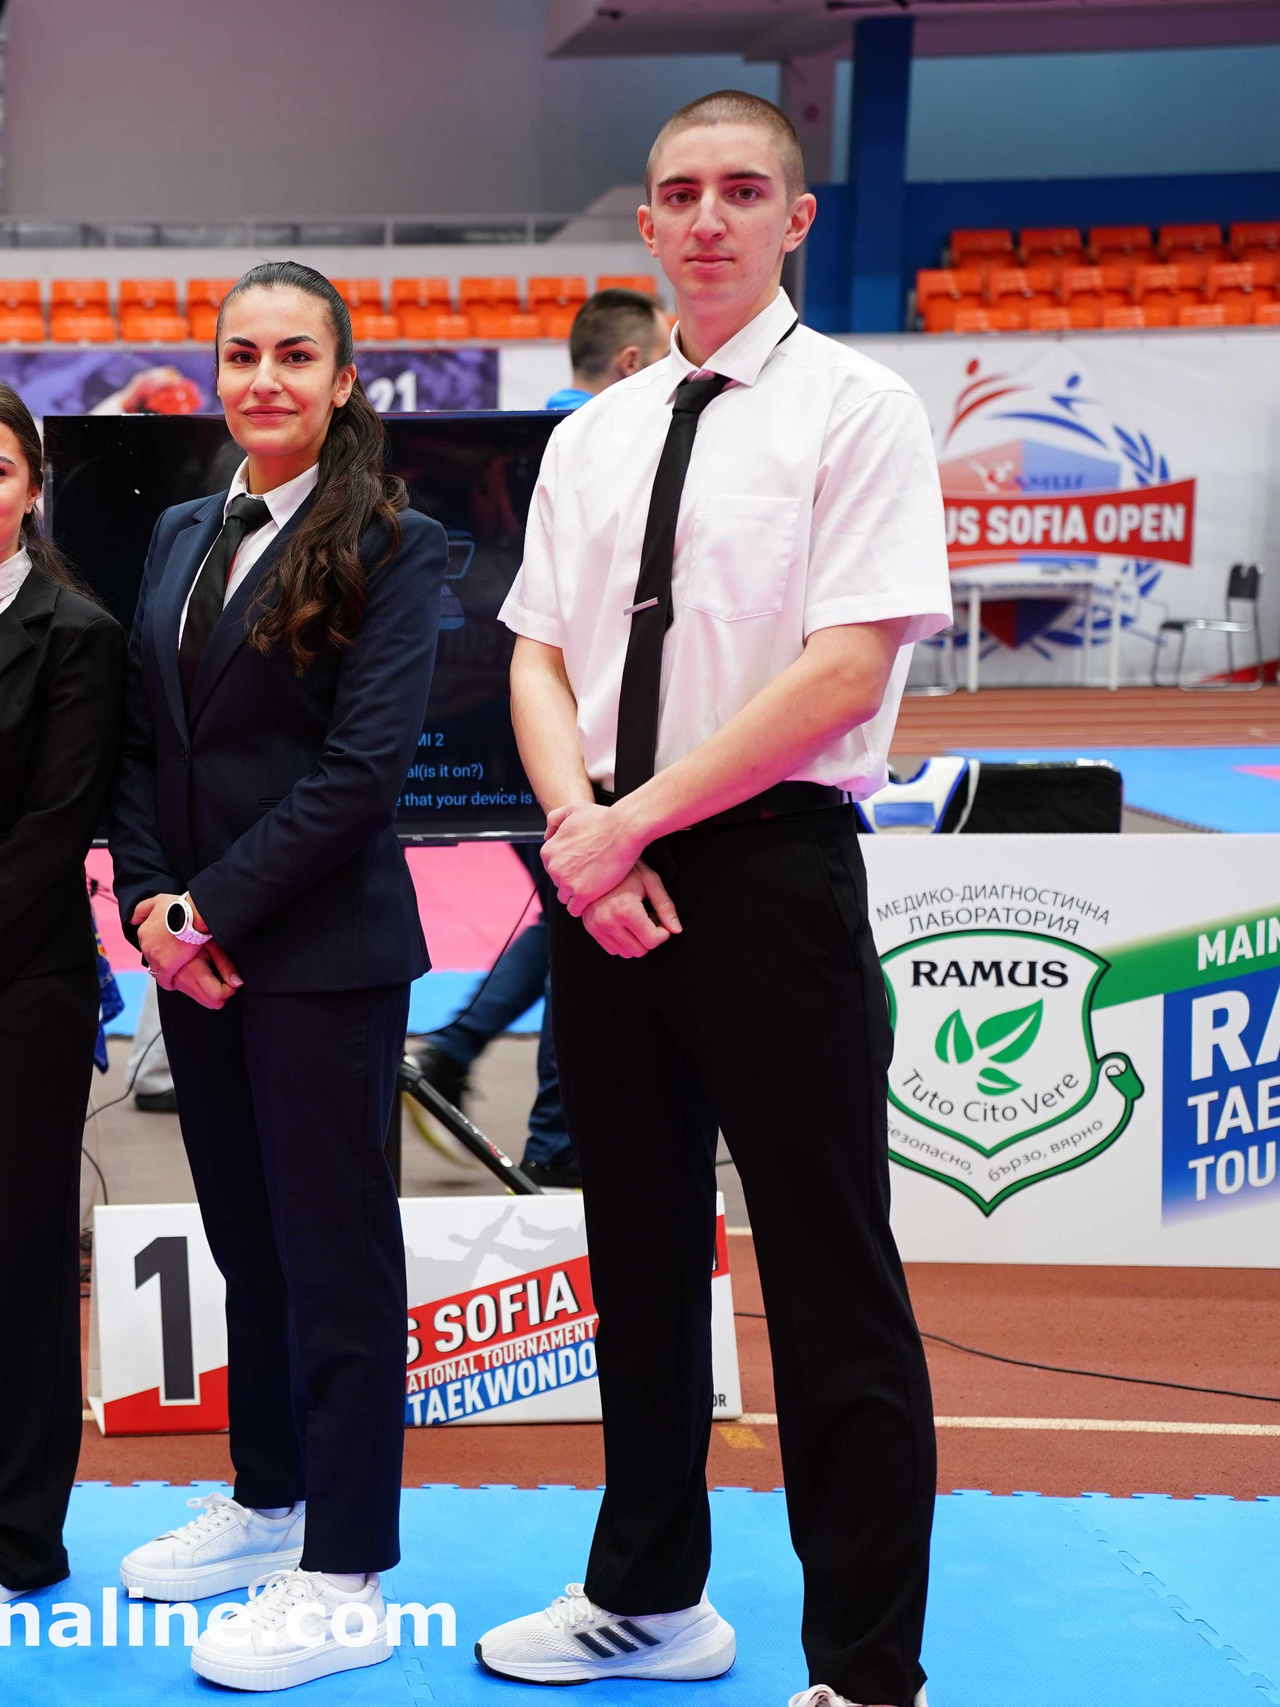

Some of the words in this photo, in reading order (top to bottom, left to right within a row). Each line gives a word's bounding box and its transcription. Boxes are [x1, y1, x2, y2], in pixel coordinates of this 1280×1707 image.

[985, 504, 1088, 545] SOFIA
[1093, 502, 1186, 543] OPEN
[435, 733, 444, 746] 2
[440, 764, 449, 778] it
[453, 763, 484, 780] on?)
[405, 792, 433, 807] that
[436, 796, 468, 809] your
[471, 791, 517, 806] device
[521, 790, 533, 805] is
[876, 884, 1111, 926] МЕДИКО-ДИАГНОСТИЧНА
[908, 906, 1081, 936] ЛАБОРАТОРИЯ
[911, 960, 1069, 988] RAMUS
[901, 1068, 955, 1117] Tuto
[963, 1100, 1018, 1123] Cito
[1021, 1072, 1080, 1115] Vere
[887, 1121, 974, 1176] езопасно,
[987, 1146, 1048, 1183] бързо,
[1050, 1118, 1104, 1154] вярно
[1188, 1140, 1278, 1202] TOU
[133, 1236, 196, 1401] 1
[433, 1270, 580, 1354] SOFIA
[407, 1354, 479, 1394] ATIONAL
[482, 1319, 596, 1368] TOURNAMENT
[408, 1341, 598, 1427] TAEKWONDO
